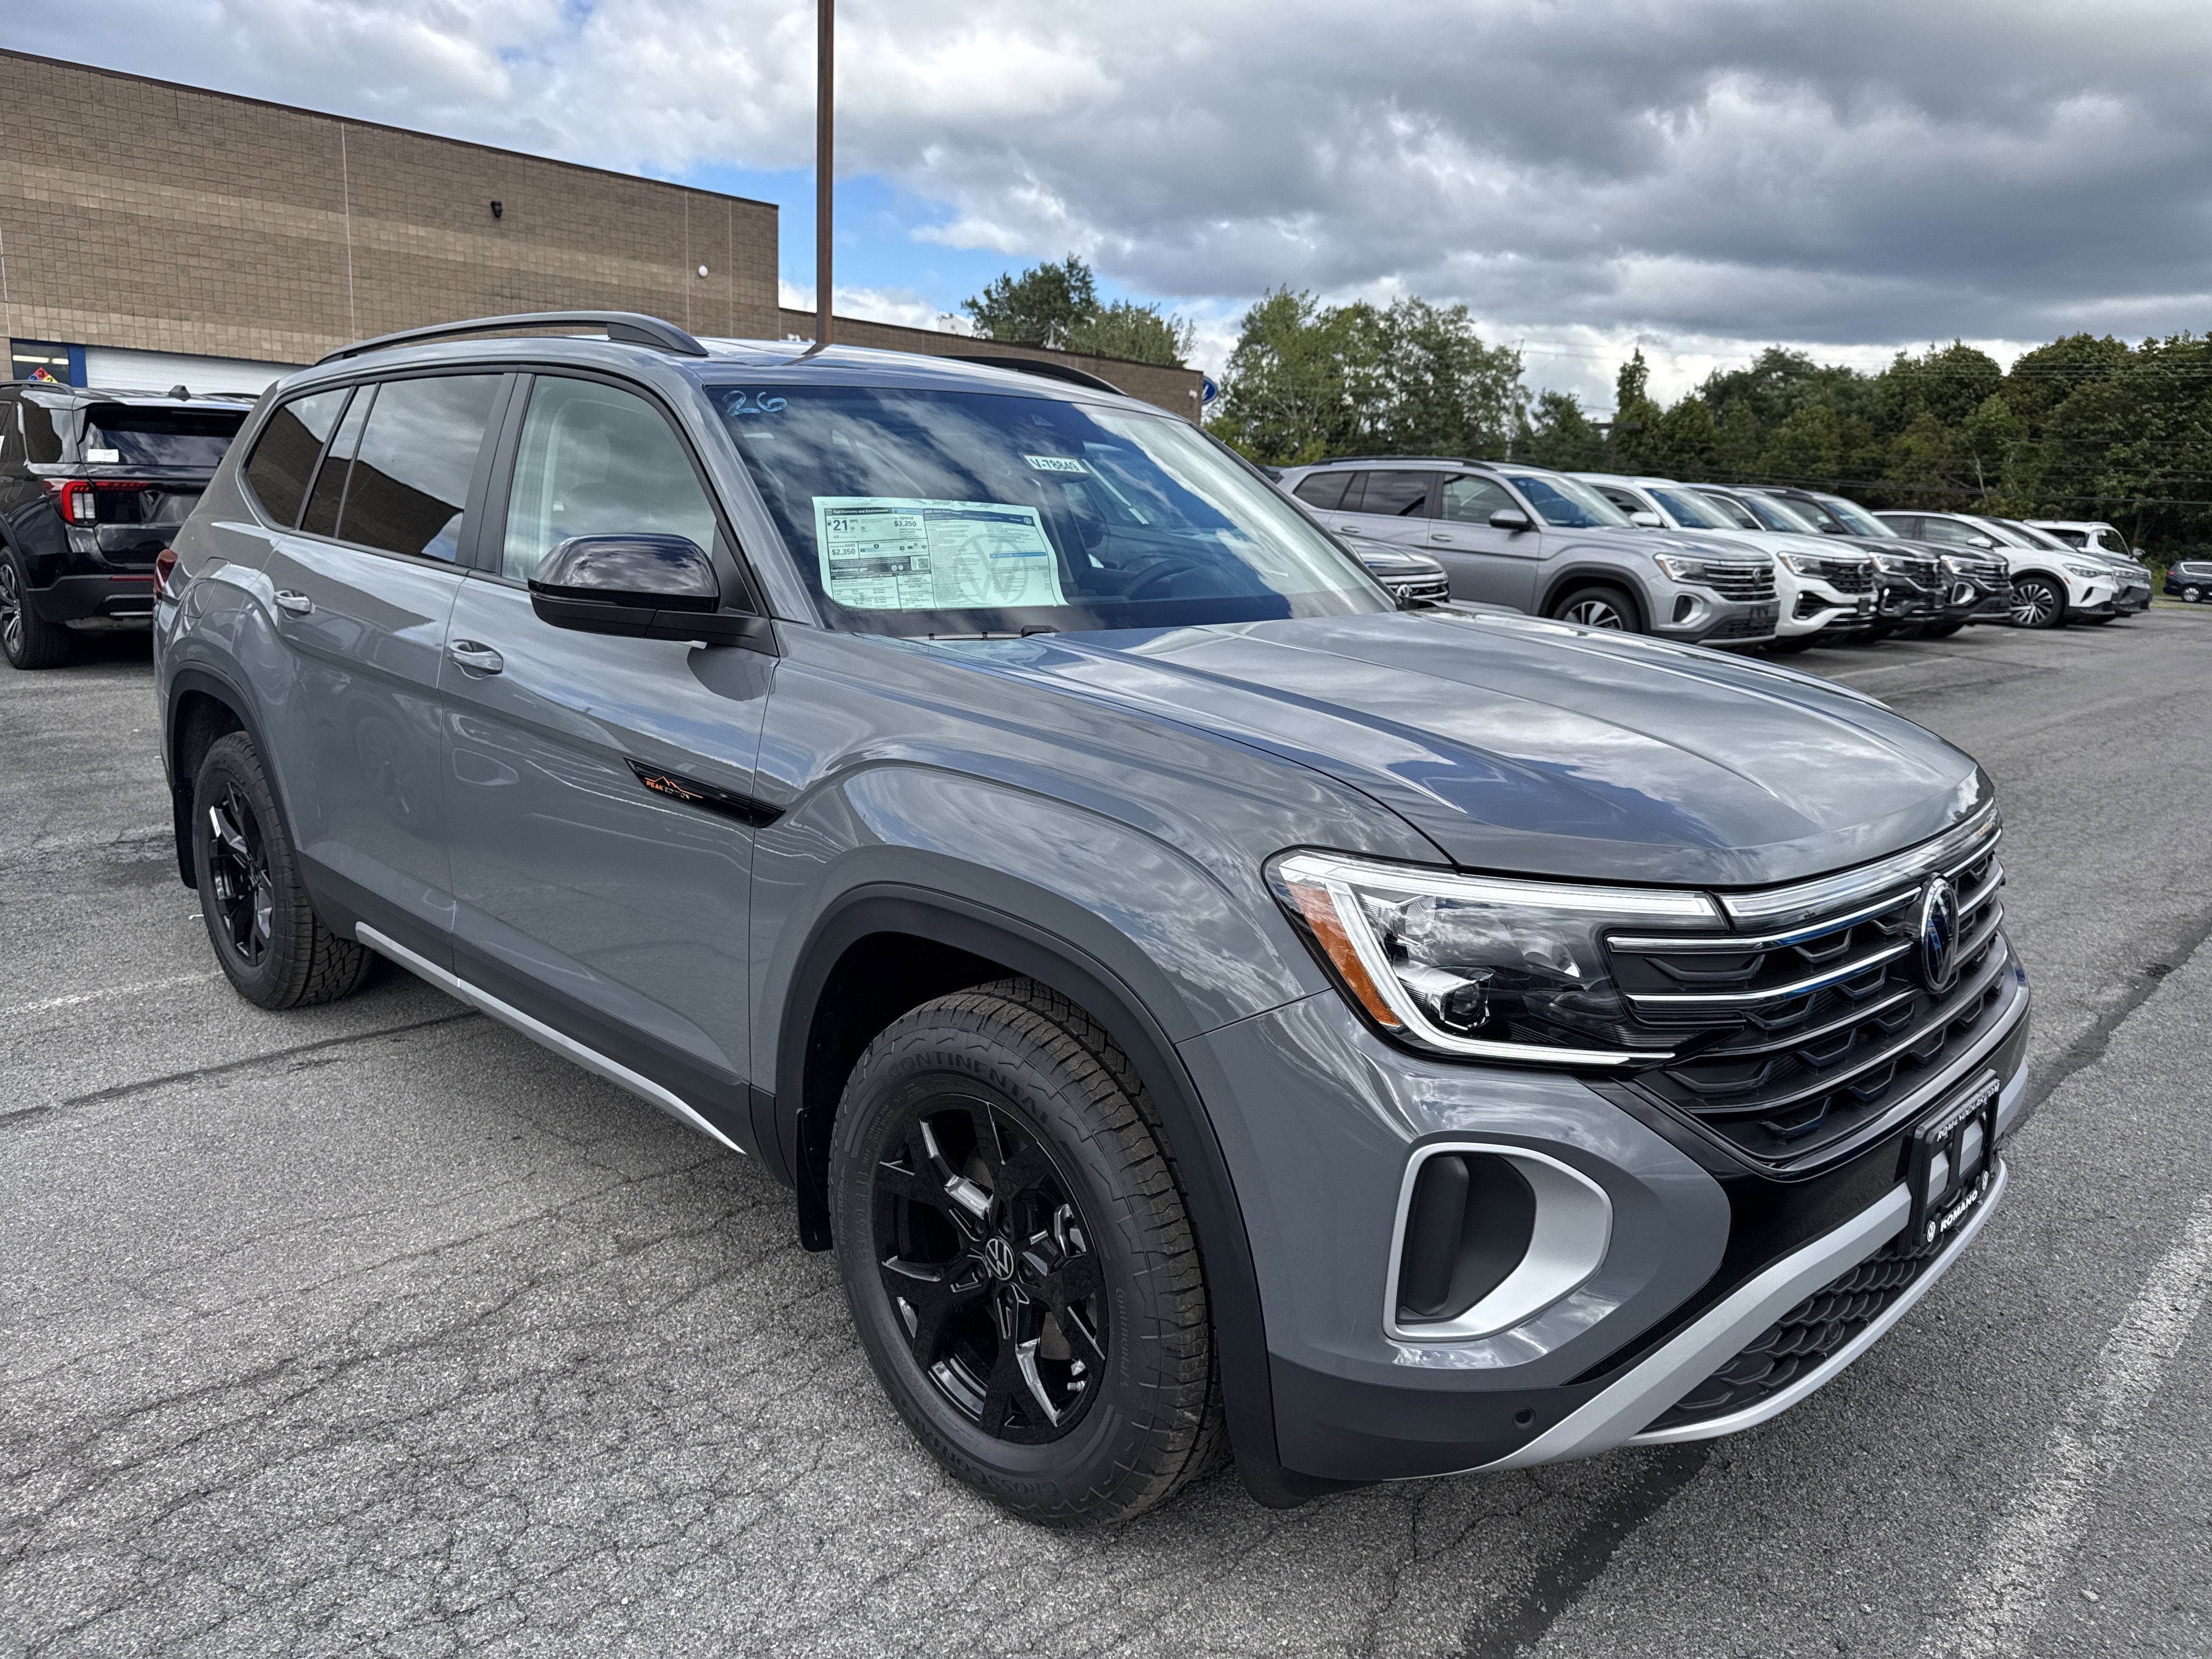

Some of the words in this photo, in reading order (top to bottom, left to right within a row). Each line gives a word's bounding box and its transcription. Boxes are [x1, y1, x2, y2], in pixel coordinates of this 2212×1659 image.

[722, 390, 788, 416] 26
[1029, 458, 1080, 471] V-78849
[833, 520, 848, 531] 21
[832, 548, 856, 556] $2,350
[646, 780, 664, 791] PEAK
[888, 1050, 1053, 1135] CONTINENTAL
[1940, 1189, 1978, 1233] ROMANO
[1115, 1286, 1131, 1379] Continental
